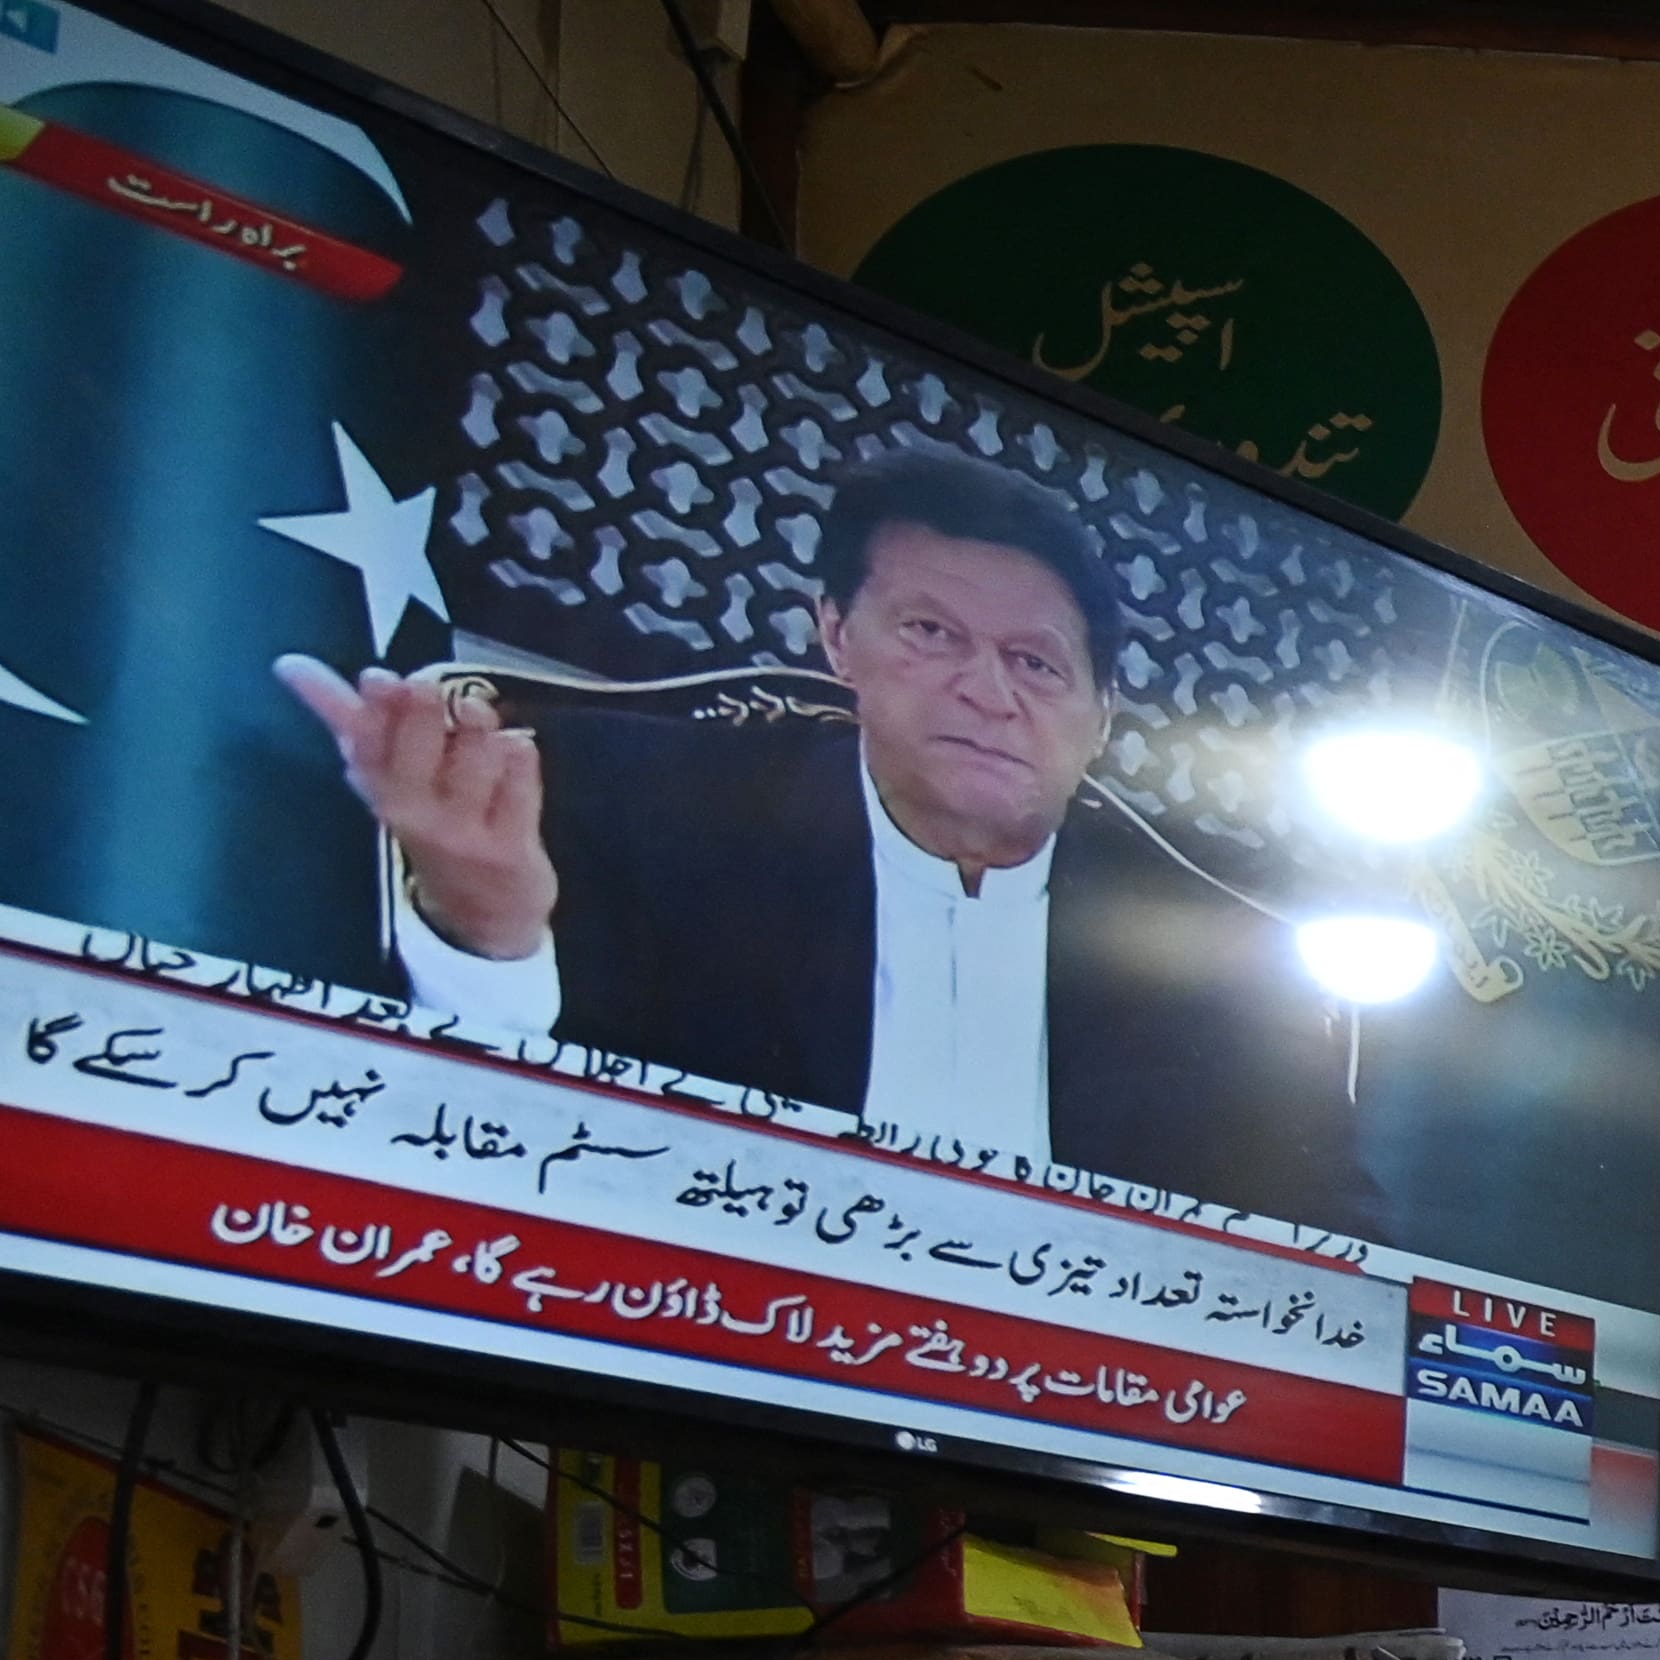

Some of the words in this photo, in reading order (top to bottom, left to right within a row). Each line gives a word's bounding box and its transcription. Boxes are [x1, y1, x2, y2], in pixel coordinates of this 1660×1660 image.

[27, 1014, 79, 1067] گا
[74, 1027, 177, 1091] سکے
[185, 1050, 274, 1098] کر
[259, 1069, 387, 1126] نہیں
[390, 1104, 526, 1161] مقابلہ
[538, 1133, 668, 1193] سسٹم
[211, 1200, 309, 1244] خان
[763, 1179, 809, 1226] تو
[816, 1190, 925, 1249] بڑھی
[322, 1224, 450, 1278] عمران
[930, 1243, 1002, 1268] سے
[1010, 1243, 1106, 1300] تیزی
[513, 1268, 608, 1314] رہے
[1109, 1271, 1202, 1309] تعداد
[1451, 1292, 1559, 1339] LIVE
[823, 1314, 904, 1368] مزید
[906, 1320, 966, 1376] ہفتے
[967, 1348, 1005, 1380] دو
[1010, 1359, 1040, 1402] پر
[1046, 1366, 1159, 1408] مقامات
[1163, 1376, 1247, 1423] عوامی
[1416, 1367, 1585, 1429] SAMAA
[915, 1434, 938, 1453] LG
